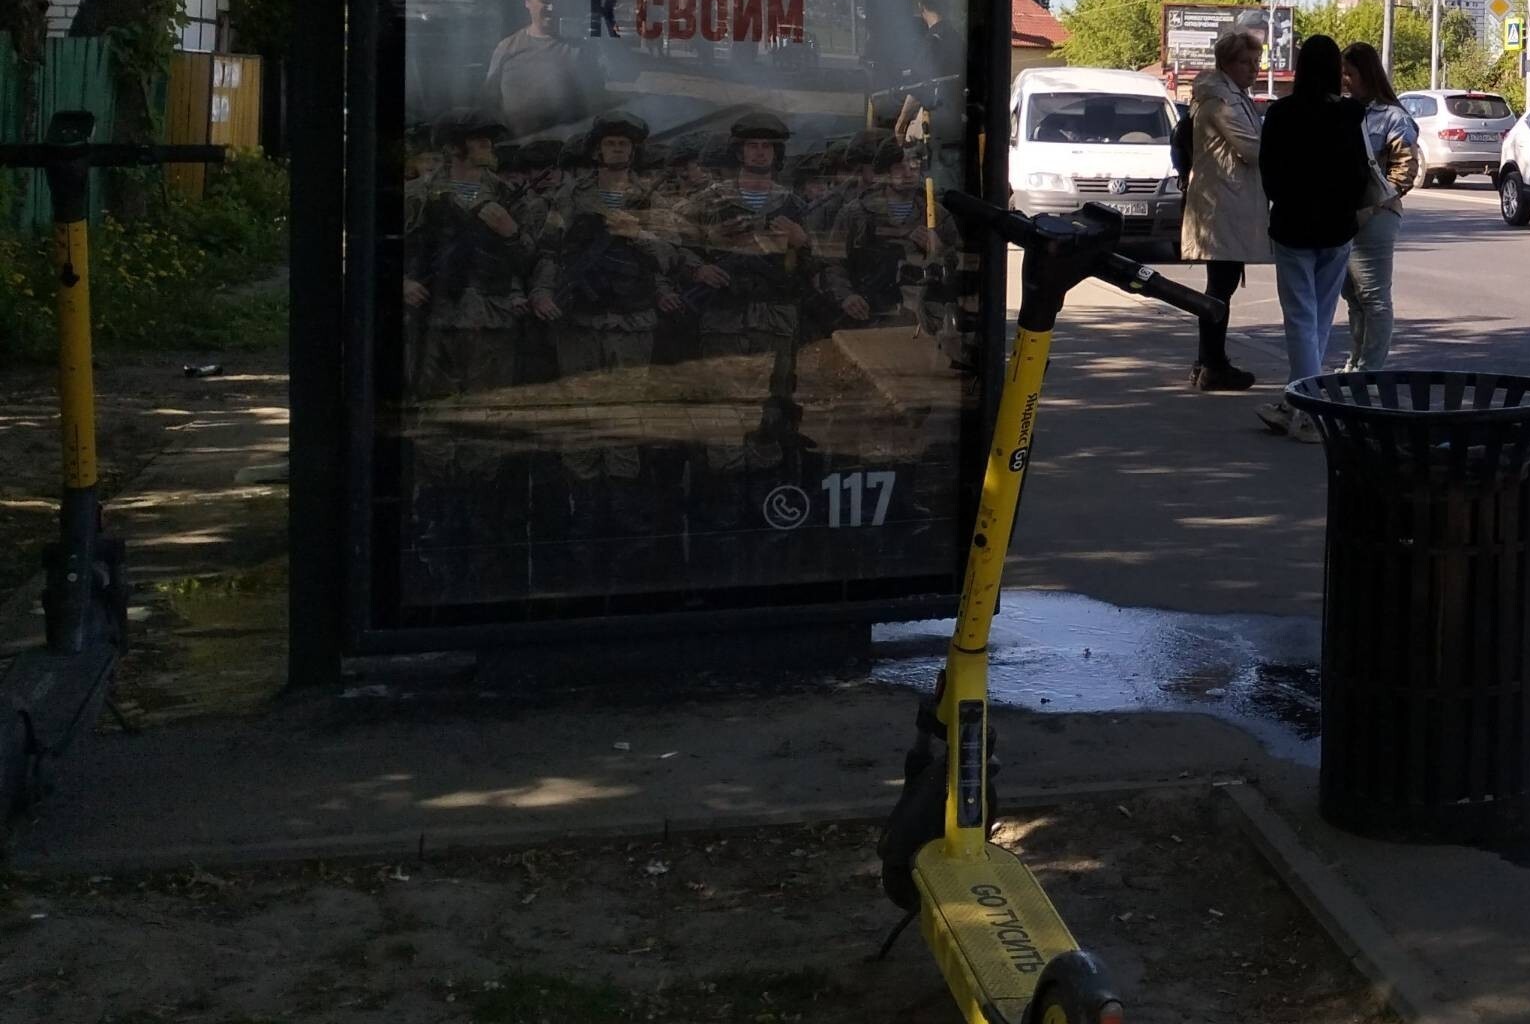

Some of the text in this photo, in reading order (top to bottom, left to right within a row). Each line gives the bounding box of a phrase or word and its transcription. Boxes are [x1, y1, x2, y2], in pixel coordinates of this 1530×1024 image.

[1017, 392, 1038, 446] Яндекс
[821, 470, 896, 528] 117
[970, 884, 1046, 973] GO ТУСИТЬ
